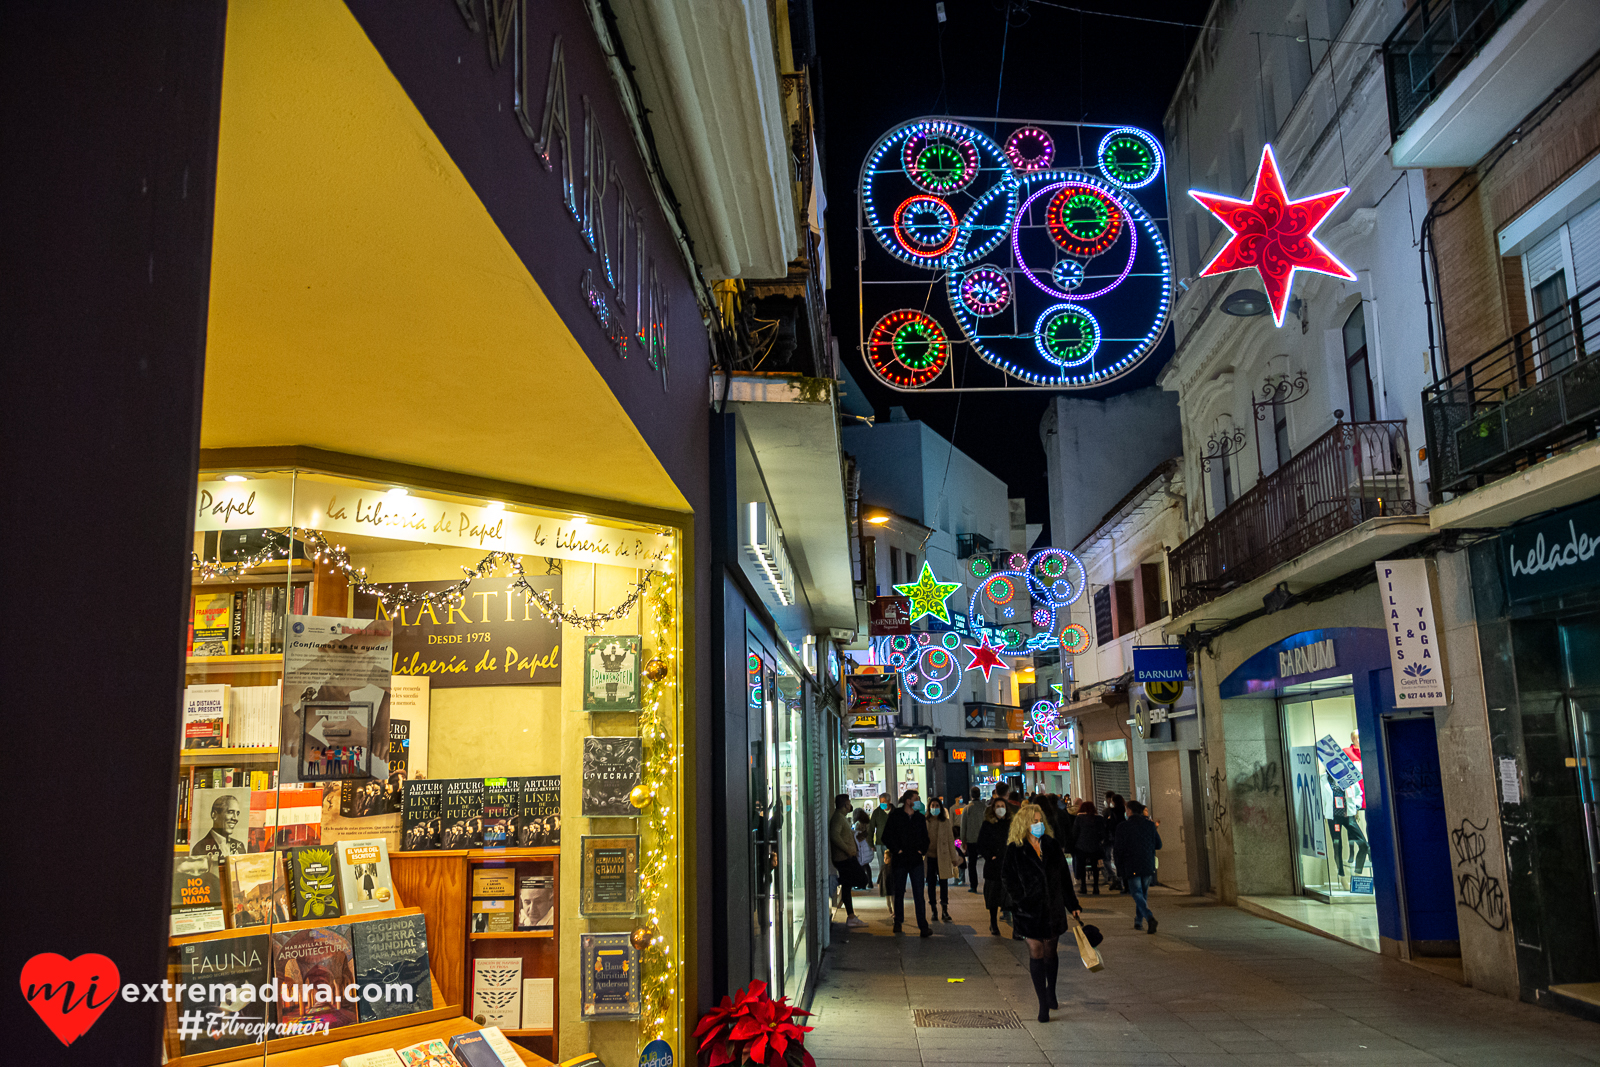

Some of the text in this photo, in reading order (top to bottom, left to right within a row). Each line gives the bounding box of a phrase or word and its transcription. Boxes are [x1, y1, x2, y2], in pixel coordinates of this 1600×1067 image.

[199, 488, 257, 524] Papel
[326, 495, 347, 520] la
[433, 512, 452, 533] de
[458, 511, 504, 546] Papel
[556, 527, 611, 555] Librería
[195, 607, 227, 616] FRANQUISMO
[375, 588, 556, 627] MARTÍN
[1384, 568, 1431, 660] PILATES & YOGA
[233, 613, 242, 637] MARX
[466, 632, 491, 643] 1978
[290, 640, 336, 649] ¡Confiamos
[392, 651, 468, 676] Librería
[475, 649, 498, 673] de
[505, 645, 559, 679] Papel
[1279, 638, 1337, 678] BARNUM
[592, 668, 633, 688] FRANKENSTEIN
[1138, 669, 1183, 679] BARNUM
[952, 748, 967, 762] Orange
[583, 772, 641, 780] LOVECRAFT
[489, 781, 519, 790] ARTUR
[524, 779, 561, 788] ARTURO
[410, 795, 440, 807] LÍNE
[448, 795, 482, 805] LÍNEA
[490, 794, 516, 804] LÍNE
[525, 793, 560, 803] LÍNEA
[488, 807, 517, 818] FUEG
[524, 806, 561, 816] FUEGO
[351, 852, 377, 860] ESCRITOR
[595, 856, 625, 864] HERMANOS
[595, 864, 625, 875] GRIMM
[187, 877, 203, 887] NO
[181, 885, 211, 896] DIGAS
[182, 894, 211, 905] NADA
[366, 920, 415, 934] SEGUNDA
[367, 929, 416, 944] GUERRA
[284, 941, 323, 951] MARAVILLAS
[368, 938, 417, 953] MUNDIAL
[278, 944, 349, 960] ARQUITECTURA
[398, 947, 417, 956] MAPA
[191, 949, 262, 975] FAUNA
[595, 980, 629, 990] Andersen
[459, 1035, 483, 1046] Odisea
